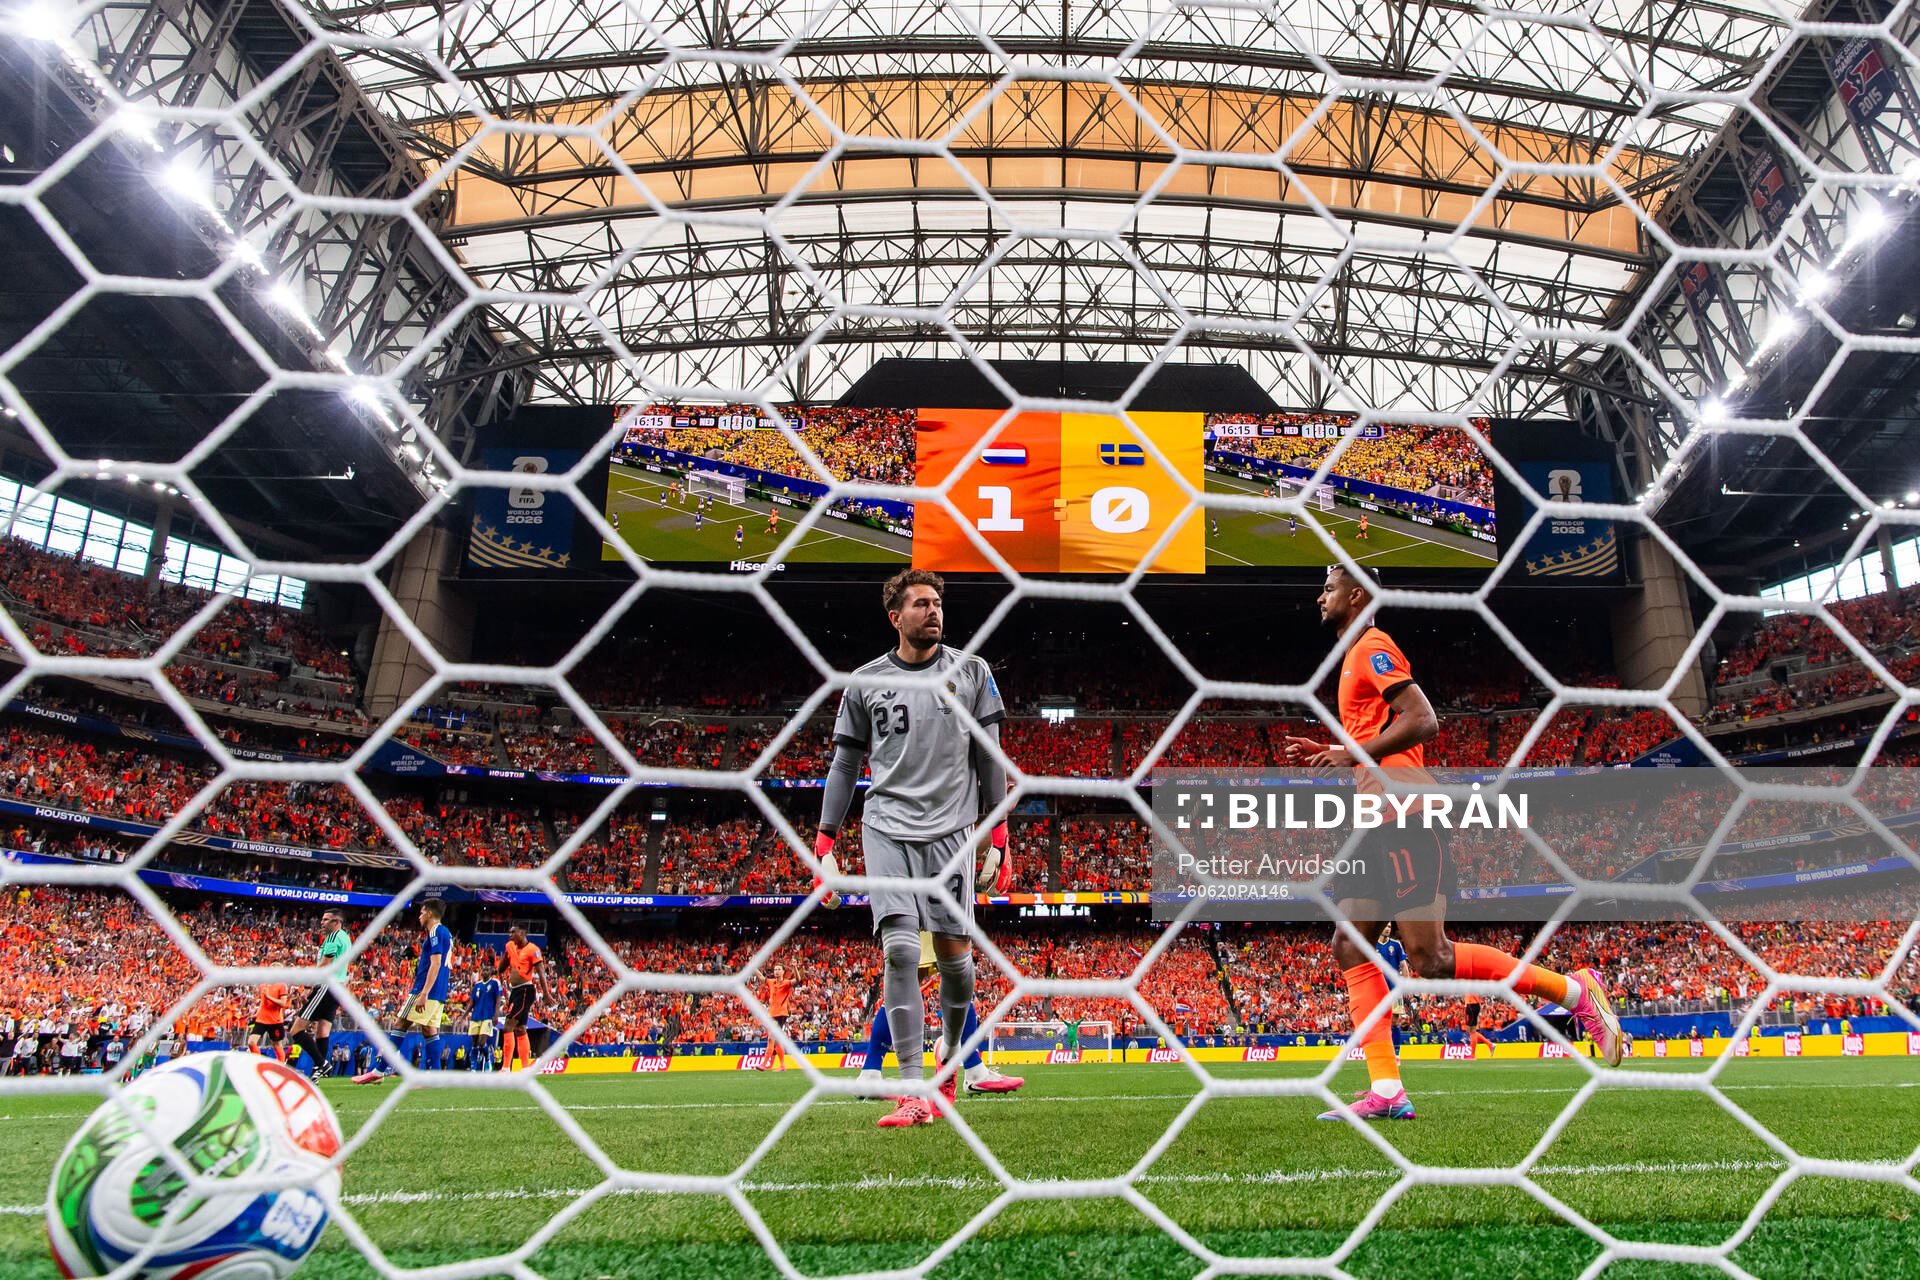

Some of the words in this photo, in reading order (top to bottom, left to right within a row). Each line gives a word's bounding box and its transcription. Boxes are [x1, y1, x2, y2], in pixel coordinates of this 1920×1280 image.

[1858, 86, 1883, 117] 2015
[1767, 200, 1786, 223] 2012
[1697, 288, 1710, 308] 2011
[699, 417, 715, 427] NED
[746, 419, 753, 427] 0
[1221, 425, 1251, 435] 16:15
[1283, 427, 1299, 435] NED
[1328, 428, 1335, 436] 0
[778, 497, 792, 506] ASKO
[1365, 503, 1379, 512] ASKO
[832, 510, 847, 520] ASKO
[977, 486, 1024, 532] 1
[1090, 486, 1150, 534] 0
[506, 516, 544, 524] 2026
[1417, 515, 1433, 526] ASKO
[895, 526, 913, 538] ASKO
[1478, 532, 1496, 543] ASKO
[25, 705, 78, 724] HOUSTON
[873, 704, 909, 737] 23
[1802, 746, 1822, 755] WORLD
[1823, 744, 1834, 752] CUP
[1834, 740, 1855, 749] 2026
[243, 750, 257, 758] CUP
[258, 752, 283, 762] 2026
[489, 770, 525, 778] HOUSTON
[35, 807, 90, 825] HOUSTON
[231, 841, 246, 850] FIFA
[247, 843, 274, 853] WORLD
[274, 846, 288, 855] CUP
[289, 848, 312, 858] 2026
[1741, 842, 1754, 850] FIFA
[1754, 839, 1776, 848] WORLD
[1776, 837, 1789, 845] CUP
[1789, 834, 1811, 843] 2026
[1388, 848, 1416, 884] 11
[1795, 873, 1811, 882] FIFA
[1811, 870, 1834, 881] WORLD
[1833, 868, 1846, 877] CUP
[1846, 864, 1868, 875] 2026
[255, 886, 273, 896] FIFA
[274, 888, 303, 899] WORLD
[304, 890, 319, 900] CUP
[319, 892, 349, 903] 2026
[573, 896, 604, 904] WORLD
[623, 897, 654, 905] 2026
[749, 897, 792, 905] HOUSTON
[1034, 893, 1044, 904] 1
[748, 1048, 767, 1056] FIF
[1150, 1048, 1178, 1063] Lay's
[1247, 1046, 1275, 1062] Lay's
[1444, 1044, 1473, 1060] Lay's
[636, 1056, 668, 1072] Lay's
